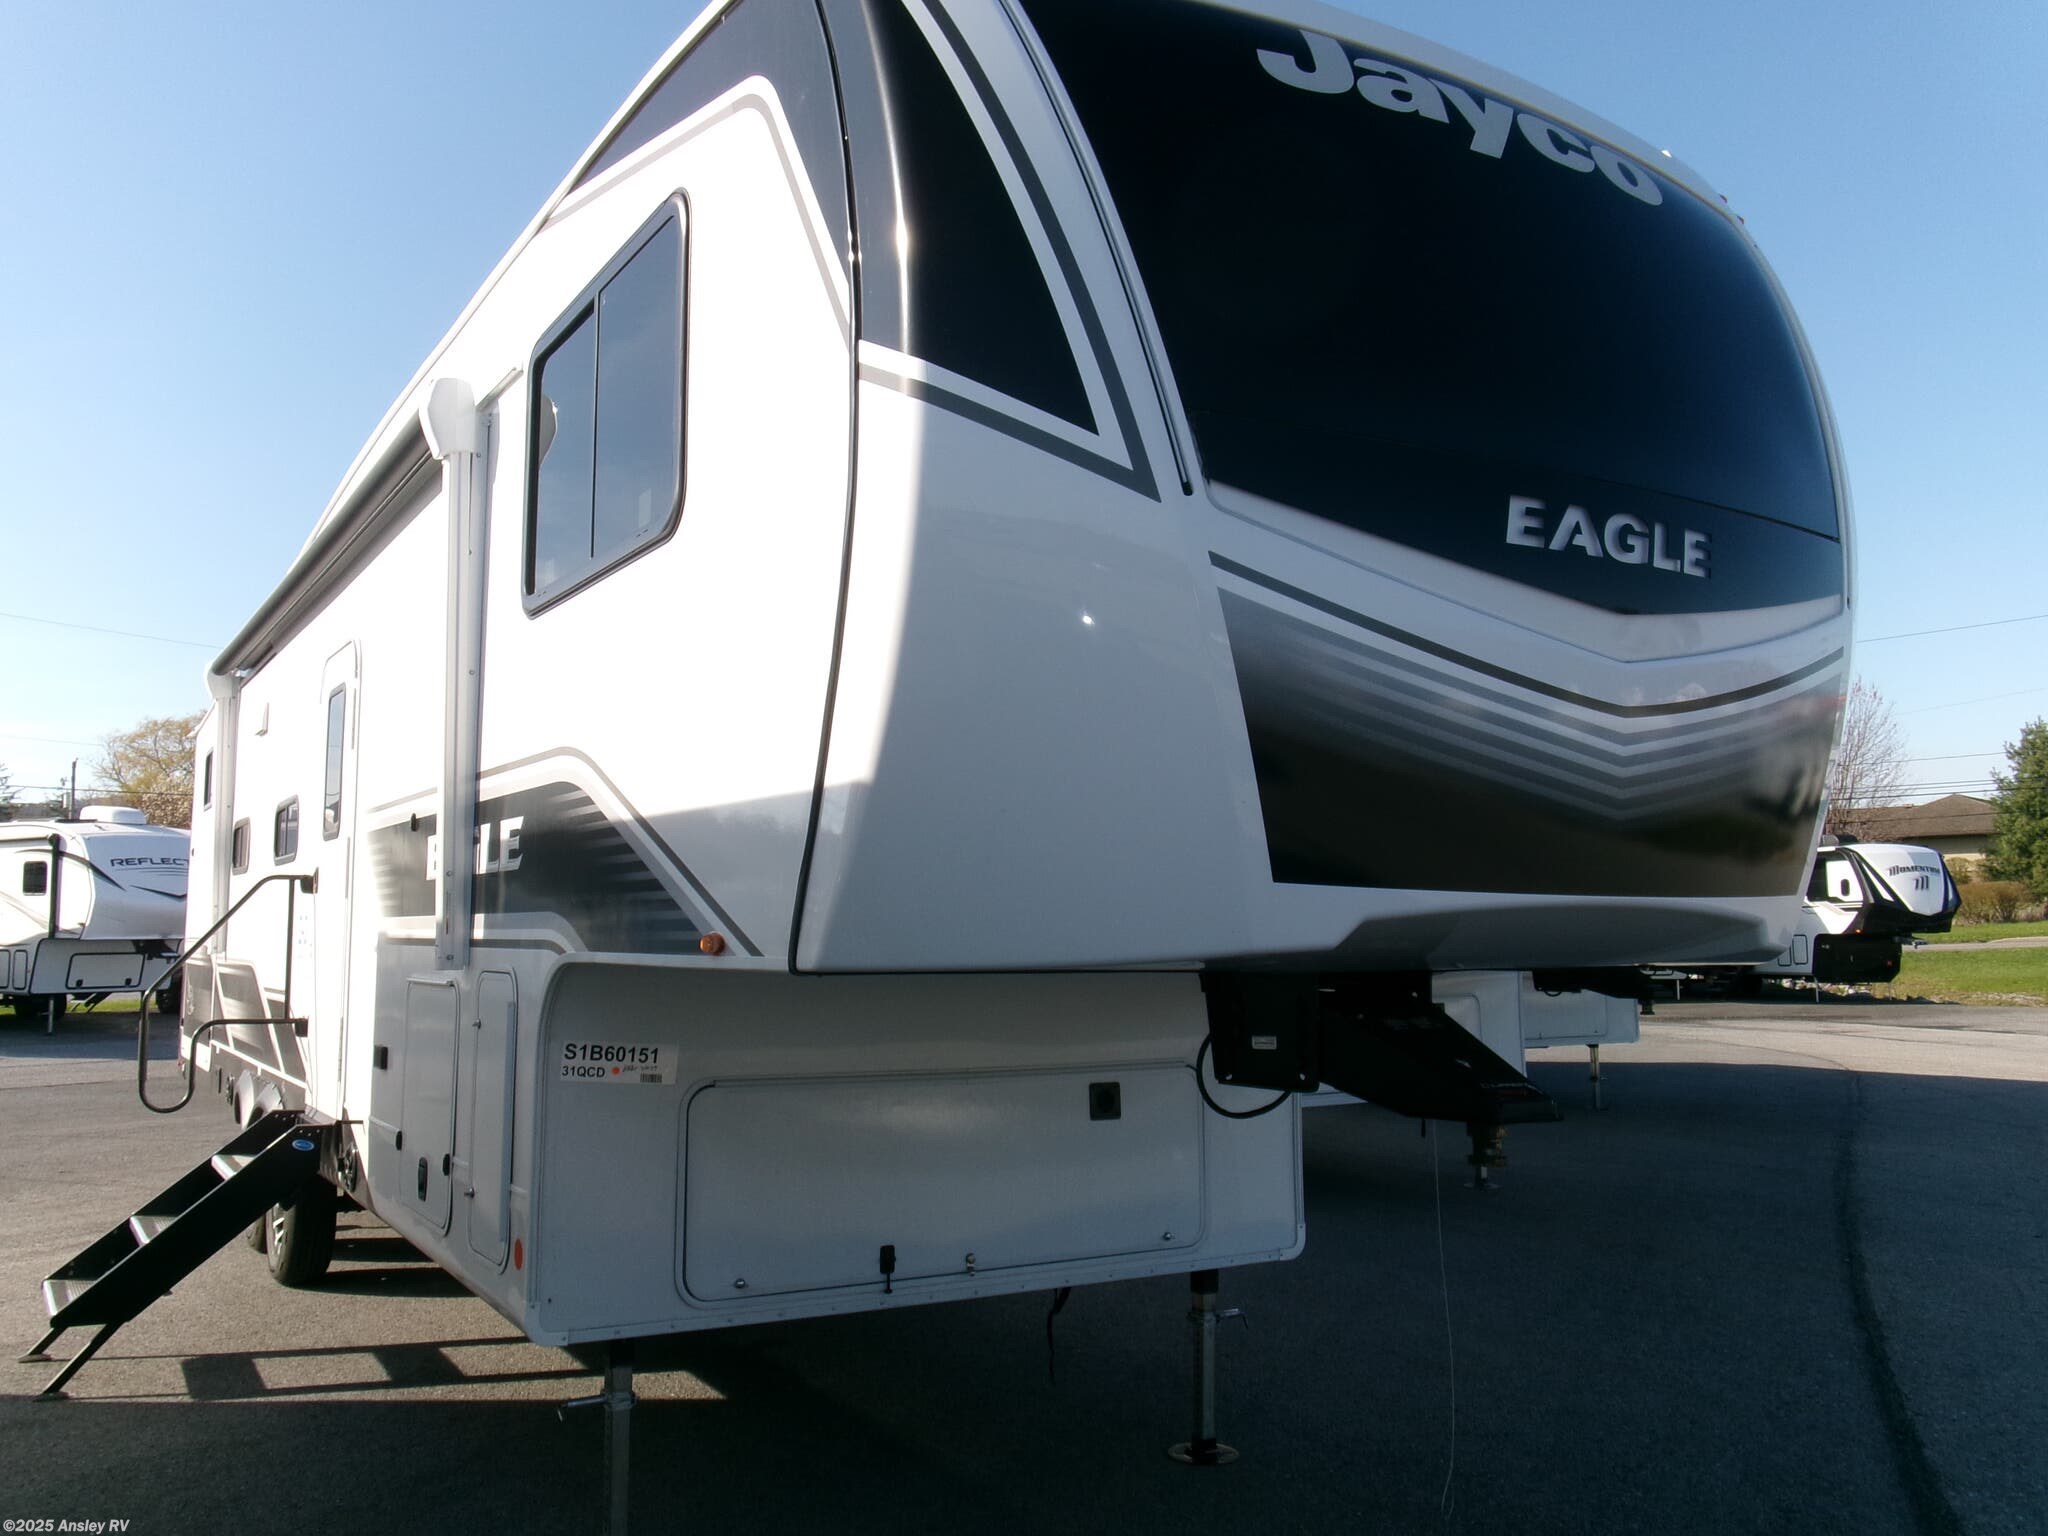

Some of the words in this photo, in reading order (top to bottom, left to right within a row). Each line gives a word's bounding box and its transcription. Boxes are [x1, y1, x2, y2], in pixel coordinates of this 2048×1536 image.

[1256, 29, 1663, 206] Jayco
[1506, 495, 1712, 578] EAGLE
[426, 816, 524, 880] ELE
[561, 1065, 606, 1078] 31QCD
[564, 1043, 659, 1064] S1B60151
